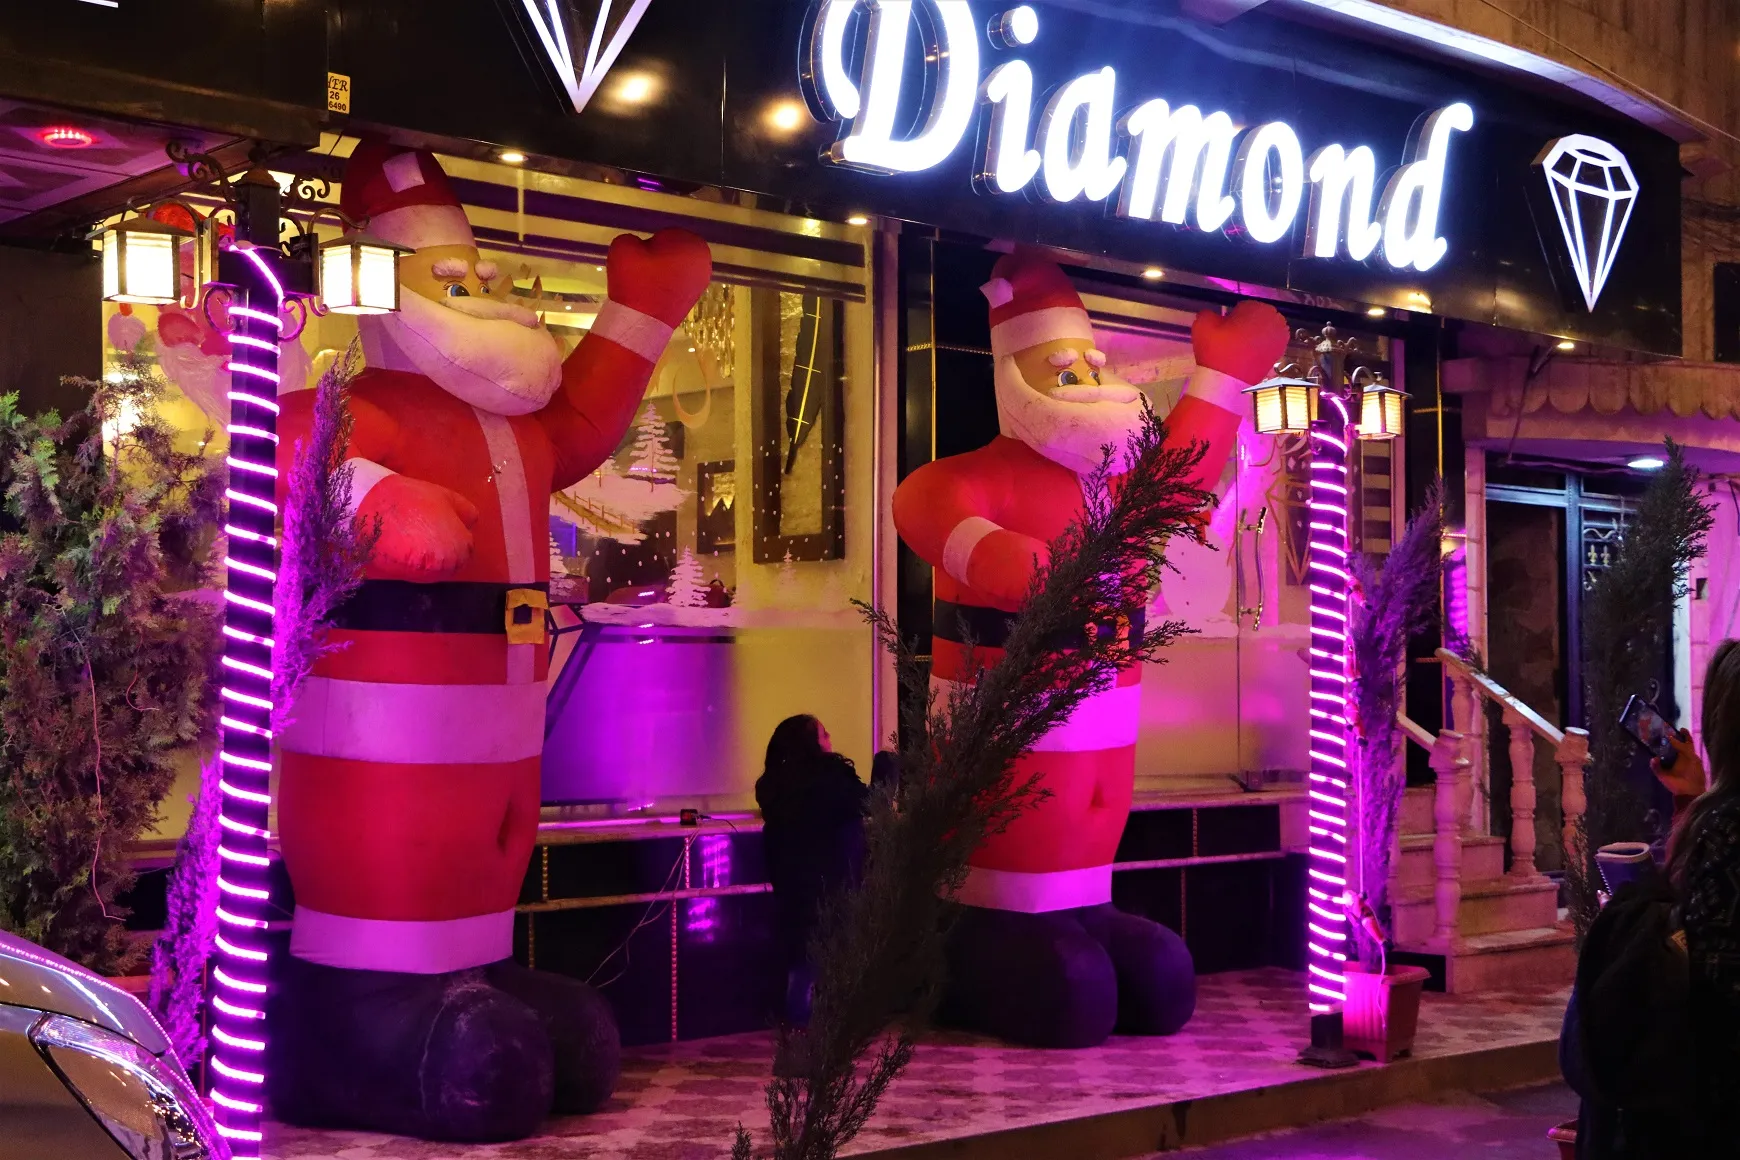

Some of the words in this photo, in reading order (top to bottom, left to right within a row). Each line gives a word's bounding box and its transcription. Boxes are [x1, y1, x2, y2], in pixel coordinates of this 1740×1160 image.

[329, 91, 340, 101] 26
[328, 100, 347, 111] 6490
[814, 0, 1474, 272] Diamond
